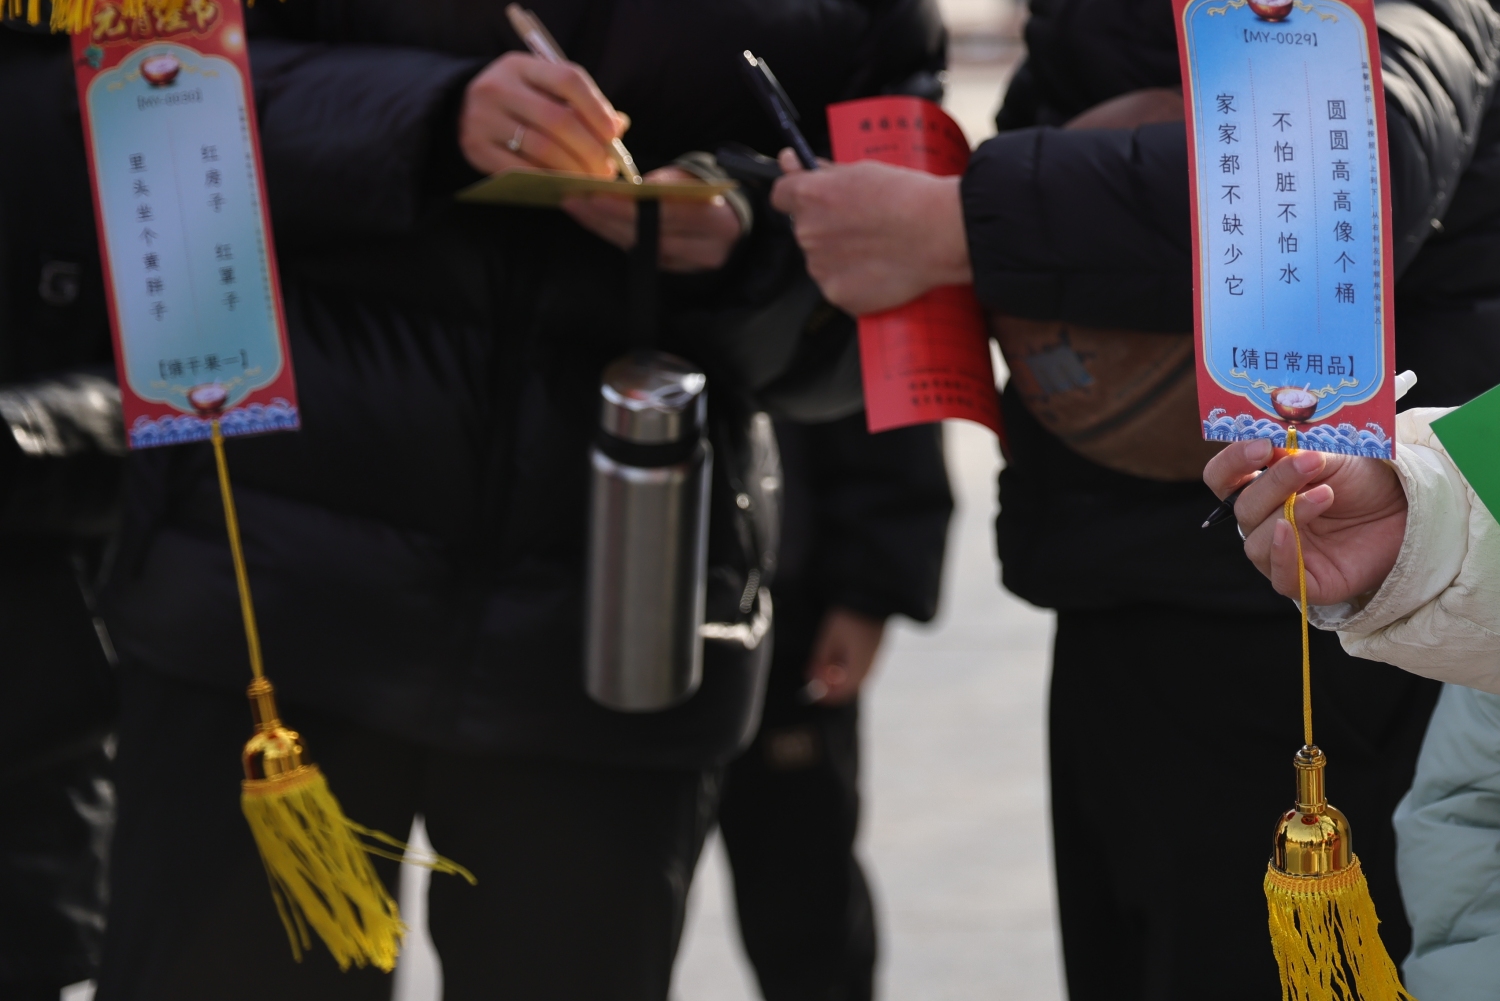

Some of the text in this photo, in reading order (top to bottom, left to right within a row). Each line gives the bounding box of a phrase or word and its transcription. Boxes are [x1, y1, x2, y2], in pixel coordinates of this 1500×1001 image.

[1215, 92, 1245, 298] 家家都不缺少它
[1271, 111, 1301, 286] 不怕脏不怕水
[1326, 98, 1356, 306] 圆圆高高像个桶
[1230, 345, 1355, 378] 【猜日常用品】
